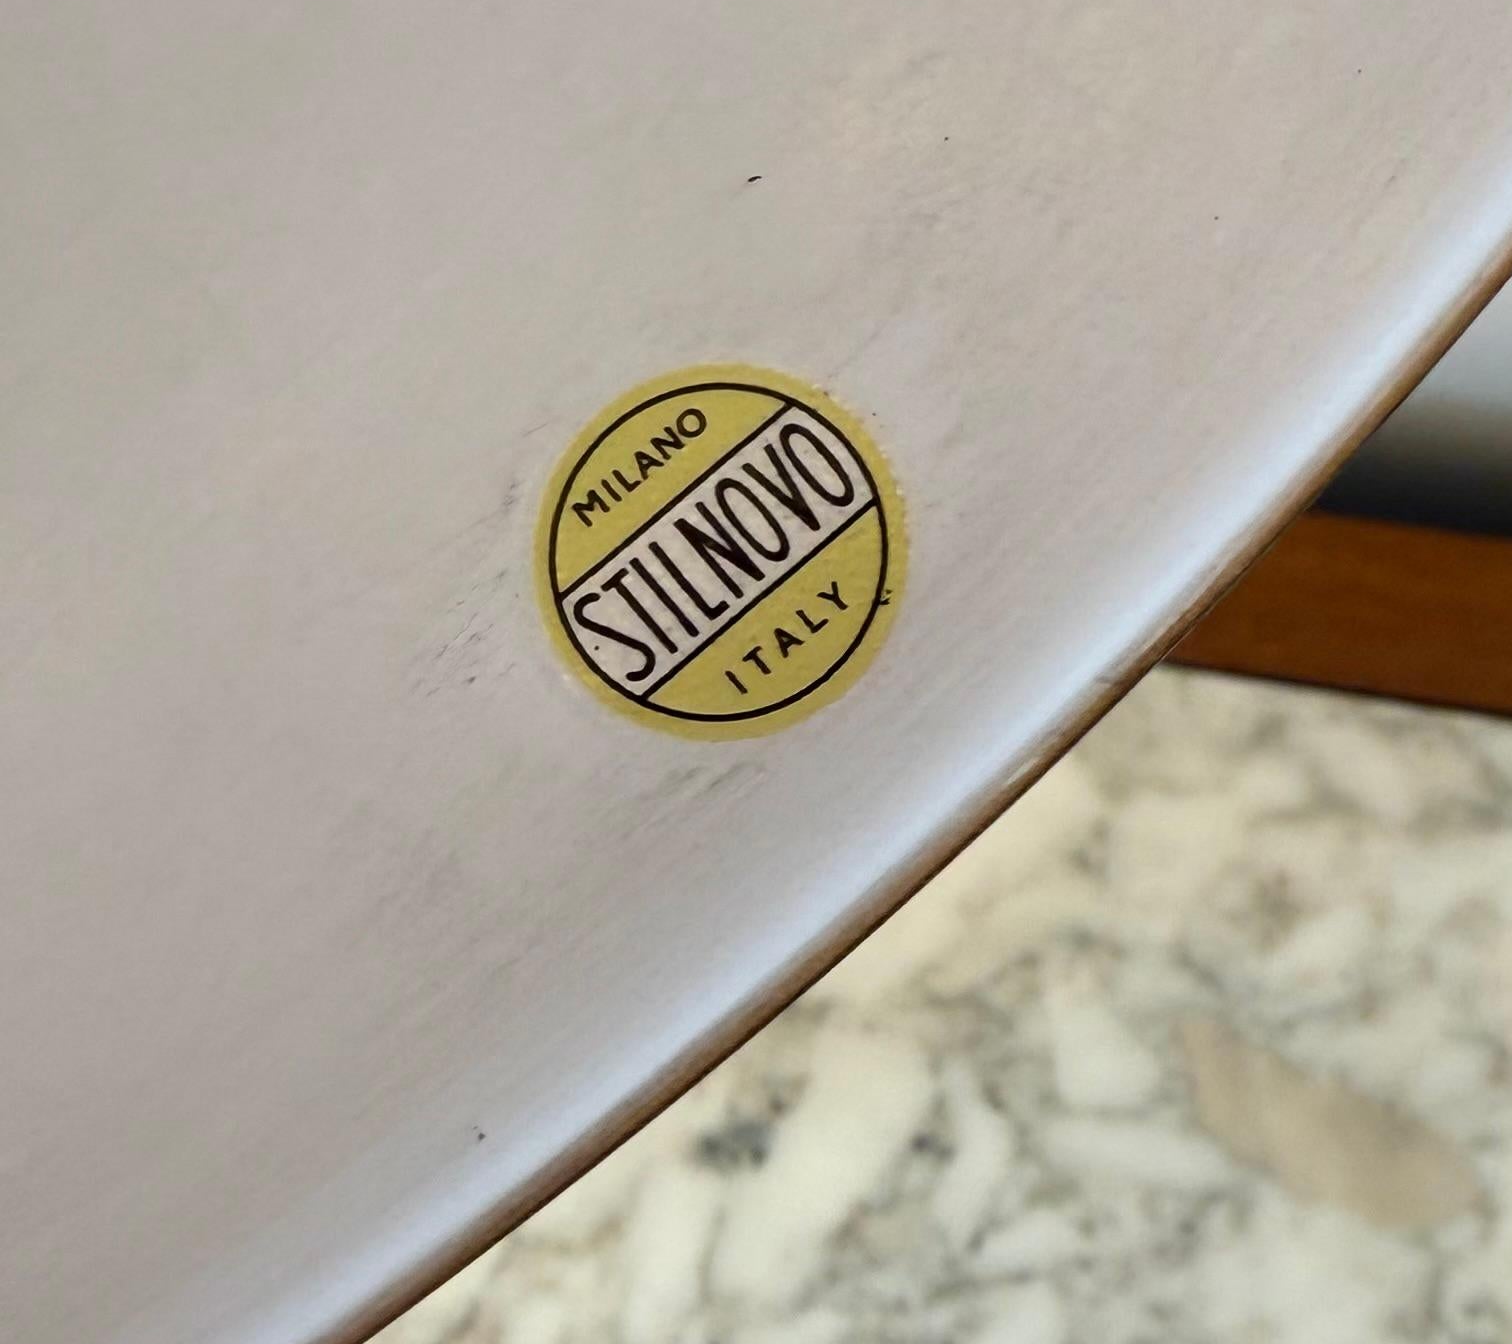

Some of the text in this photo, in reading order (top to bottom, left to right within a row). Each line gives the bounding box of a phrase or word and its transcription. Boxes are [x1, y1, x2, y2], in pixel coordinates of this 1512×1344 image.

[571, 408, 708, 527] MILANO
[573, 423, 854, 682] STILNOVO
[724, 581, 848, 695] ITALY
